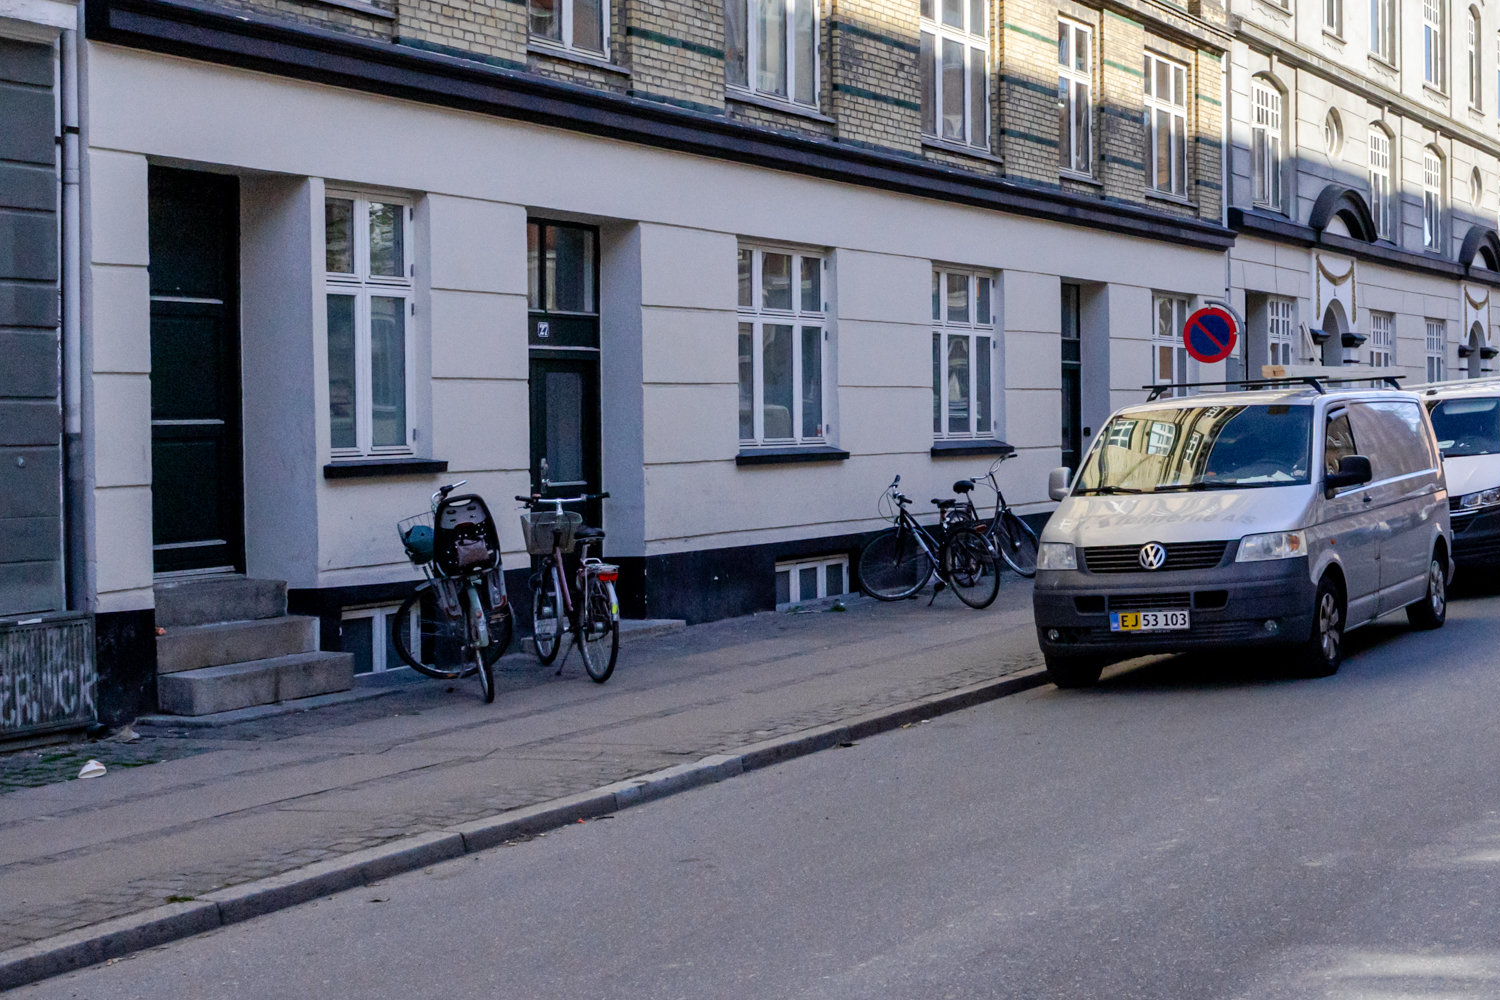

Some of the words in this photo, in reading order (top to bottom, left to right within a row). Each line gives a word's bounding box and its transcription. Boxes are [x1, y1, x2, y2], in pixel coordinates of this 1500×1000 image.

[1121, 614, 1139, 628] EJ
[1142, 614, 1159, 627] 53
[1163, 613, 1187, 627] 103
